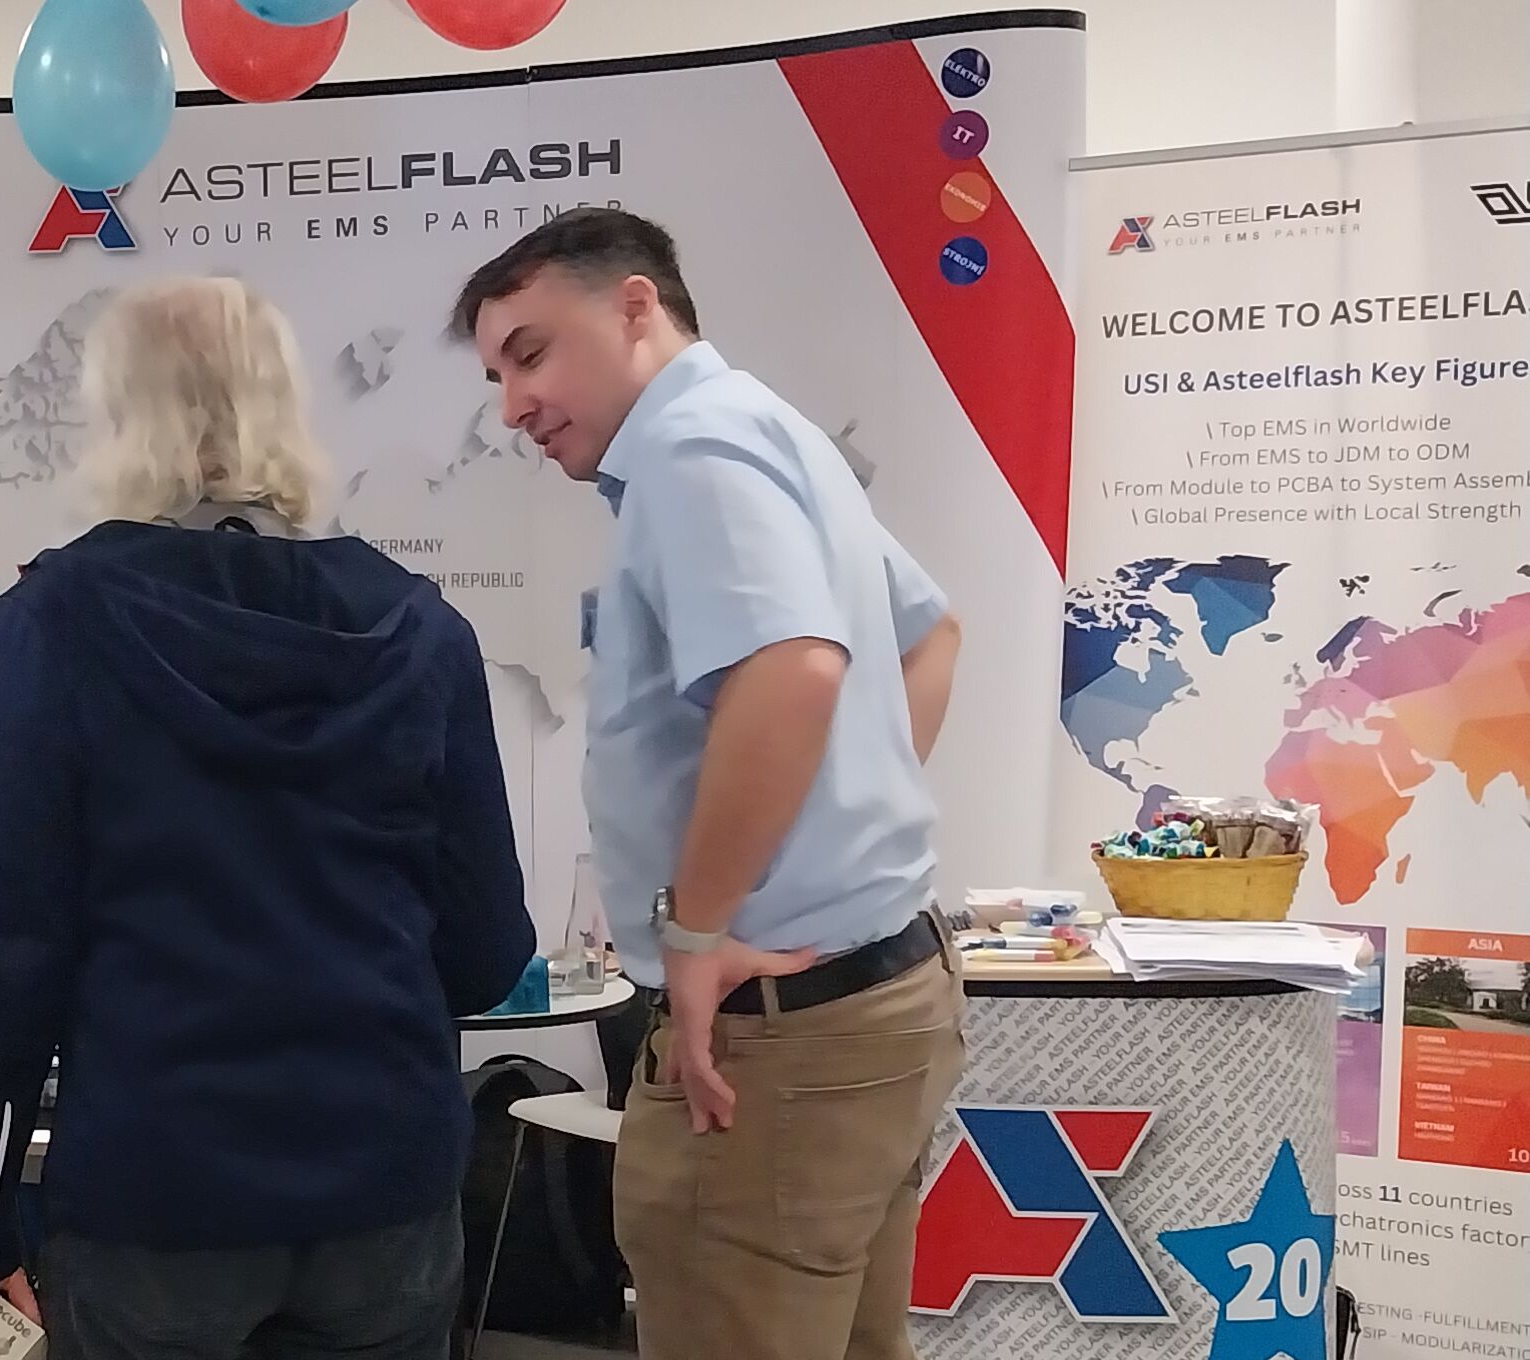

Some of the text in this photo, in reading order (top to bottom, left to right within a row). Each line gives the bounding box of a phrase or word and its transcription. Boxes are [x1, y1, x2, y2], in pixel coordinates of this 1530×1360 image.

[945, 59, 986, 87] ELEKTRO
[952, 125, 975, 144] IT
[159, 139, 623, 204] ASTEELFLASH
[1162, 198, 1361, 229] ASTEELFLASH
[164, 221, 273, 247] YOUR
[306, 214, 390, 240] EMS
[1163, 223, 1361, 248] YOUR EMS PARTNER
[1101, 289, 1530, 339] WELCOME TO ASTEELFLA
[1123, 357, 1529, 395] USI & Asteelflash Key Figure
[1219, 421, 1256, 439] Top
[1263, 420, 1307, 437] EMS
[1314, 419, 1330, 435] in
[1337, 414, 1452, 434] Worldwide
[1199, 450, 1249, 466] From
[1257, 448, 1300, 465] EMS
[1308, 448, 1328, 463] to
[1335, 446, 1380, 463] JDM
[1388, 445, 1409, 462] to
[1416, 443, 1470, 461] ODM
[1114, 481, 1163, 498] From
[1170, 477, 1244, 496] Module
[1250, 478, 1270, 494] to
[1278, 476, 1334, 493] PCBA
[1340, 476, 1361, 492] to
[1368, 474, 1447, 495] System
[1144, 507, 1208, 525] Global
[1214, 506, 1307, 524] Presence
[1314, 503, 1357, 521] with
[1364, 502, 1419, 520] Local
[1427, 500, 1521, 523] Strength
[451, 572, 524, 588] REPUBLIC
[1468, 939, 1502, 952] ASIA
[1092, 1008, 1147, 1060] YOUR EMS
[1189, 1003, 1240, 1055] YOUR EMS
[1191, 1007, 1255, 1076] ASTEELFLASH
[1048, 1014, 1120, 1083] EMS PARTNER
[1082, 1027, 1151, 1094] ASTEELFLASH
[1156, 1042, 1181, 1067] EMS
[1191, 1028, 1256, 1097] EMS PARTNER
[1106, 1046, 1154, 1091] PARTNER
[1220, 1056, 1250, 1087] YOUR
[1122, 1155, 1176, 1206] YOUR EMS
[1123, 1161, 1191, 1227] ASTEELFLASH
[1379, 1185, 1401, 1203] 11
[1409, 1191, 1513, 1216] countries
[1335, 1211, 1530, 1248] chatronics factor
[1381, 1243, 1430, 1266] lines
[1225, 1236, 1321, 1321] 20
[1357, 1301, 1413, 1321] ESTING
[1362, 1326, 1387, 1339] SIP
